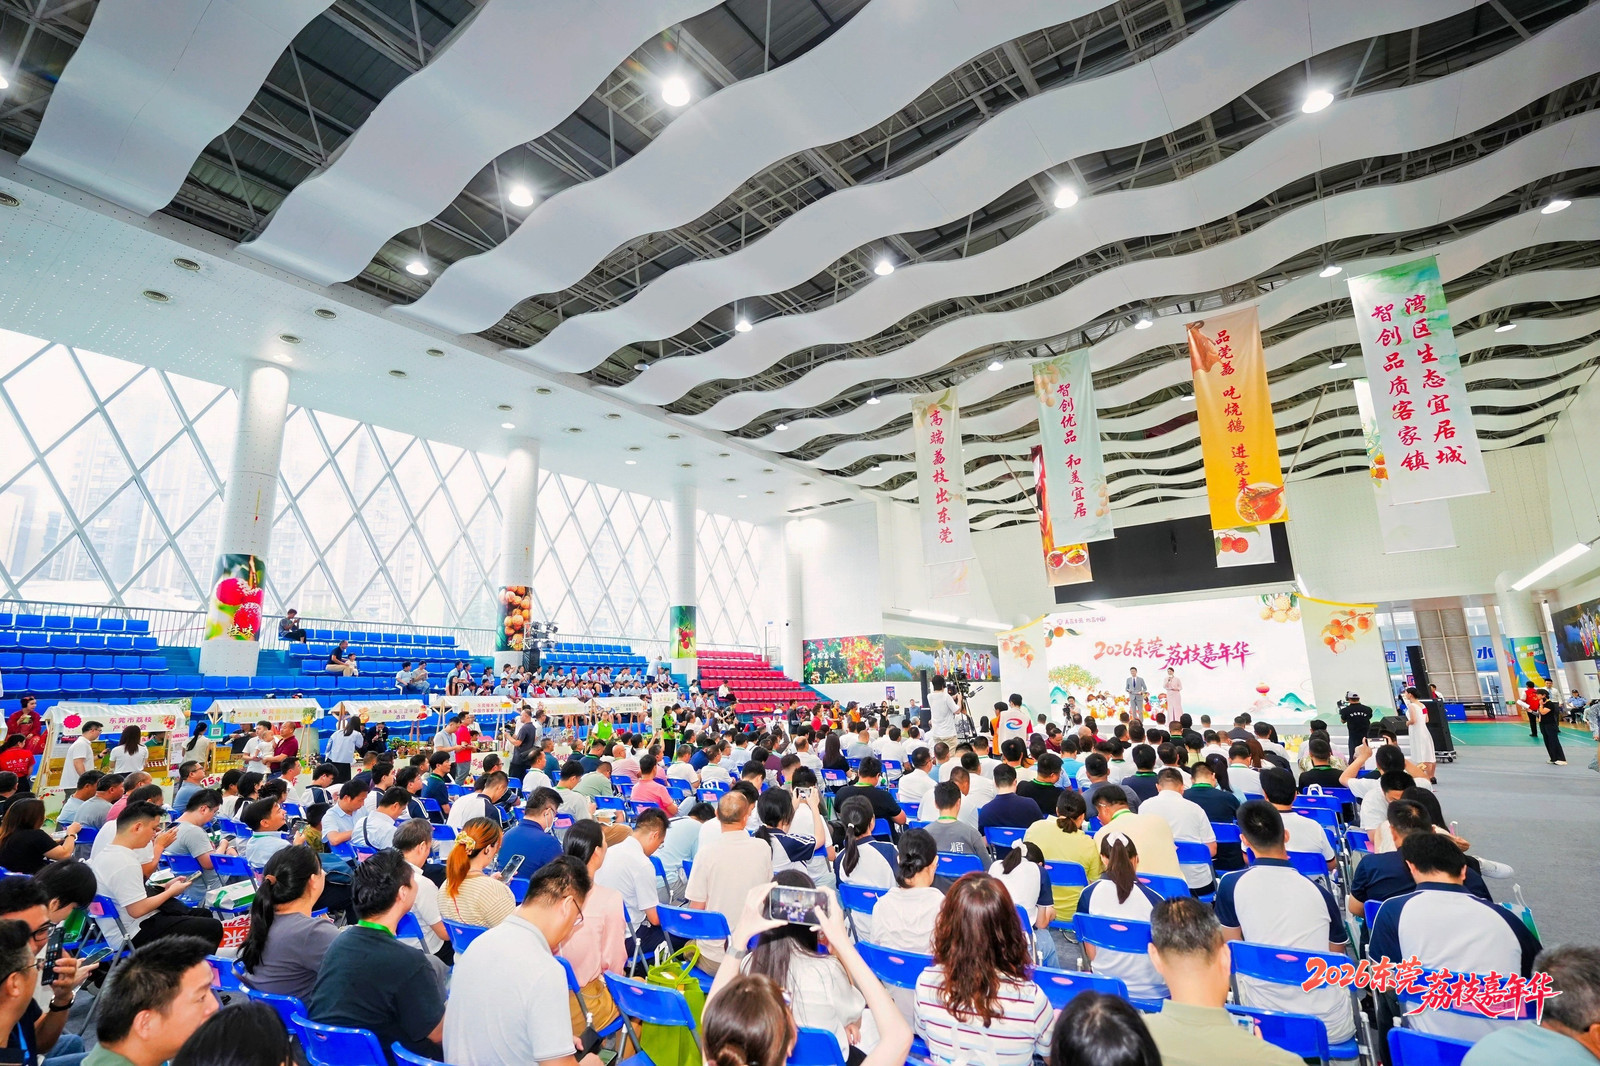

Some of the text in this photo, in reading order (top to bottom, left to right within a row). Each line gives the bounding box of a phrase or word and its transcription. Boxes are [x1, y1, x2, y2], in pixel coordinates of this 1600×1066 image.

[1215, 329, 1236, 377] 品莞荔
[1371, 303, 1430, 472] 智创品质客家镇
[1404, 294, 1467, 466] 湾区生态宜居城
[1223, 386, 1246, 434] 吃烧鹅
[1056, 383, 1088, 520] 智创优品 和美宜居
[929, 410, 954, 545] 高端荔枝出东莞
[1093, 636, 1256, 671] 2026东莞荔枝嘉年华
[1476, 646, 1494, 660] 水
[109, 716, 152, 725] 东莞市荔枝
[112, 724, 148, 732] 产业会
